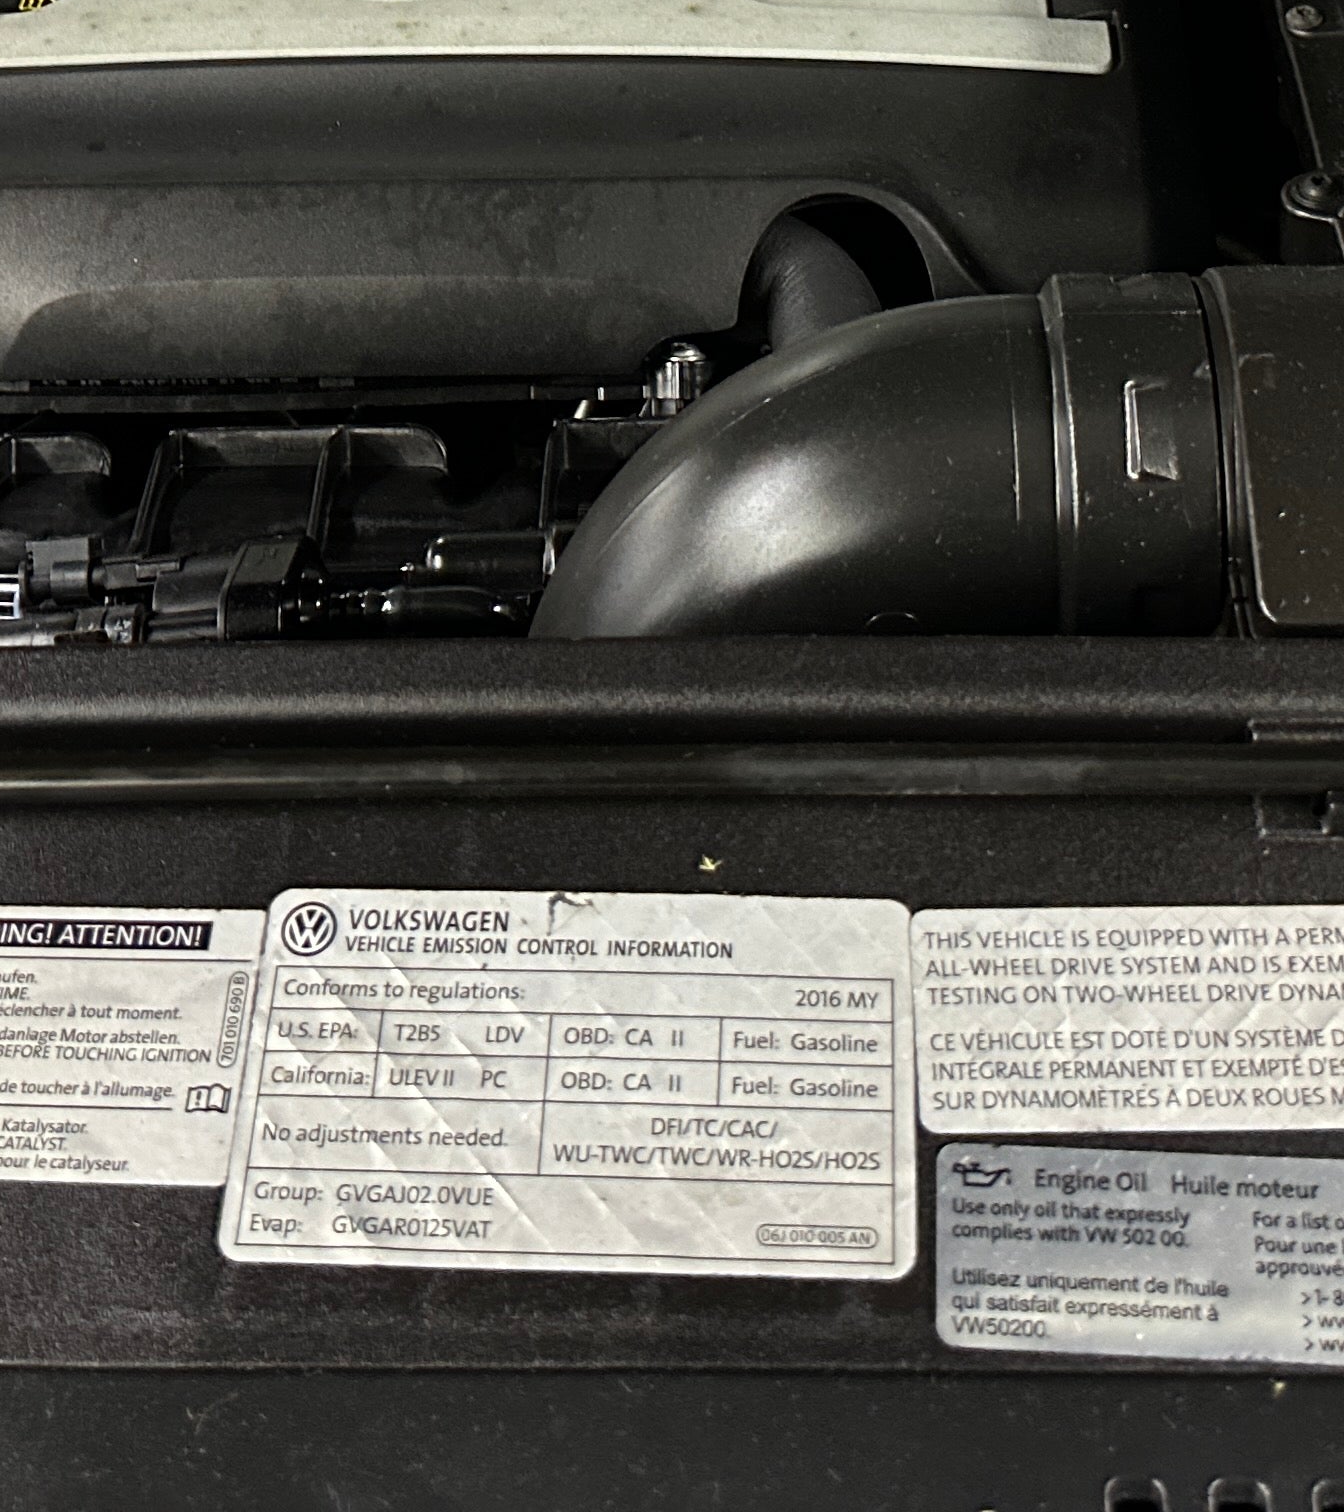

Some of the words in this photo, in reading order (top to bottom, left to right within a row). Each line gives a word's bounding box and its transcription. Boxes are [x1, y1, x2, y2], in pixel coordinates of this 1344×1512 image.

[350, 909, 509, 932] VOLKSWAGEN
[57, 924, 202, 946] ATTENTION!
[924, 930, 971, 948] THIS
[976, 930, 1065, 948] VEHICLE
[1072, 930, 1089, 946] IS
[1096, 929, 1203, 950] EQUIPPED
[1209, 928, 1267, 945] WITH
[1276, 928, 1290, 944] A
[345, 937, 414, 952] VEHICLE
[423, 938, 506, 954] EMISSION
[517, 939, 597, 956] CONTROL
[607, 940, 732, 958] INFORMATION
[926, 958, 1044, 977] ALL-WHEEL
[1051, 958, 1114, 975] DRIVE
[1122, 957, 1200, 974] SYSTEM
[1207, 956, 1255, 973] AND
[1263, 956, 1280, 973] IS
[229, 987, 244, 1013] 690
[284, 978, 378, 997] Conforms
[384, 981, 404, 997] to
[409, 980, 525, 1002] regulations:
[795, 990, 841, 1007] 2016
[847, 992, 878, 1009] MY
[927, 986, 1016, 1004] TESTING
[1023, 986, 1056, 1003] ON
[1062, 985, 1201, 1003] TWO-WHEEL
[1208, 984, 1271, 1001] DRIVE
[61, 1029, 106, 1043] Motor
[109, 1031, 180, 1045] abstellen.
[226, 1015, 239, 1037] 010
[278, 1022, 313, 1037] U.S.
[319, 1023, 358, 1039] EPA:
[395, 1024, 440, 1041] T2B5
[486, 1026, 524, 1043] LDV
[564, 1027, 614, 1044] OBD:
[625, 1029, 652, 1046] CA
[671, 1030, 683, 1046] II
[734, 1032, 779, 1049] Fuel:
[791, 1034, 877, 1052] Gasoline
[55, 1047, 137, 1061] TOUCHING
[141, 1049, 211, 1063] IGNITION
[221, 1045, 235, 1061] 701
[271, 1066, 370, 1084] California:
[389, 1069, 438, 1085] ULEV
[442, 1069, 454, 1086] II
[481, 1070, 505, 1088] PC
[561, 1072, 612, 1090] OBD:
[624, 1073, 650, 1091] CA
[669, 1074, 680, 1091] II
[732, 1077, 778, 1094] Fuel:
[790, 1078, 878, 1097] Gasoline
[262, 1124, 290, 1141] No
[296, 1125, 422, 1148] adjustments
[429, 1127, 507, 1146] needed.
[651, 1118, 777, 1139] DFI/TC/CAC/
[254, 1181, 322, 1202] Group:
[337, 1183, 493, 1205] GVGAJ02.0VUE
[1034, 1169, 1109, 1194] Engine
[1116, 1172, 1146, 1191] Oil
[1172, 1175, 1228, 1195] Huile
[1236, 1181, 1318, 1199] moteur
[953, 1198, 986, 1215] Use
[990, 1201, 1030, 1220] only
[1034, 1202, 1055, 1218] oil
[1061, 1204, 1099, 1220] that
[1105, 1208, 1190, 1228] expressly
[1253, 1211, 1279, 1227] For
[1287, 1216, 1297, 1228] a
[1302, 1212, 1329, 1230] list
[250, 1215, 303, 1238] Evap:
[332, 1216, 492, 1238] GVGAR0125VAT
[790, 1229, 814, 1242] 010
[818, 1230, 845, 1244] 005
[848, 1231, 870, 1244] AN
[953, 1224, 1033, 1244] complies
[1038, 1227, 1079, 1242] with
[1085, 1228, 1117, 1242] VW
[1122, 1229, 1154, 1245] 502
[1160, 1231, 1188, 1247] 00.
[1255, 1236, 1294, 1253] Pour
[1302, 1239, 1336, 1254] une
